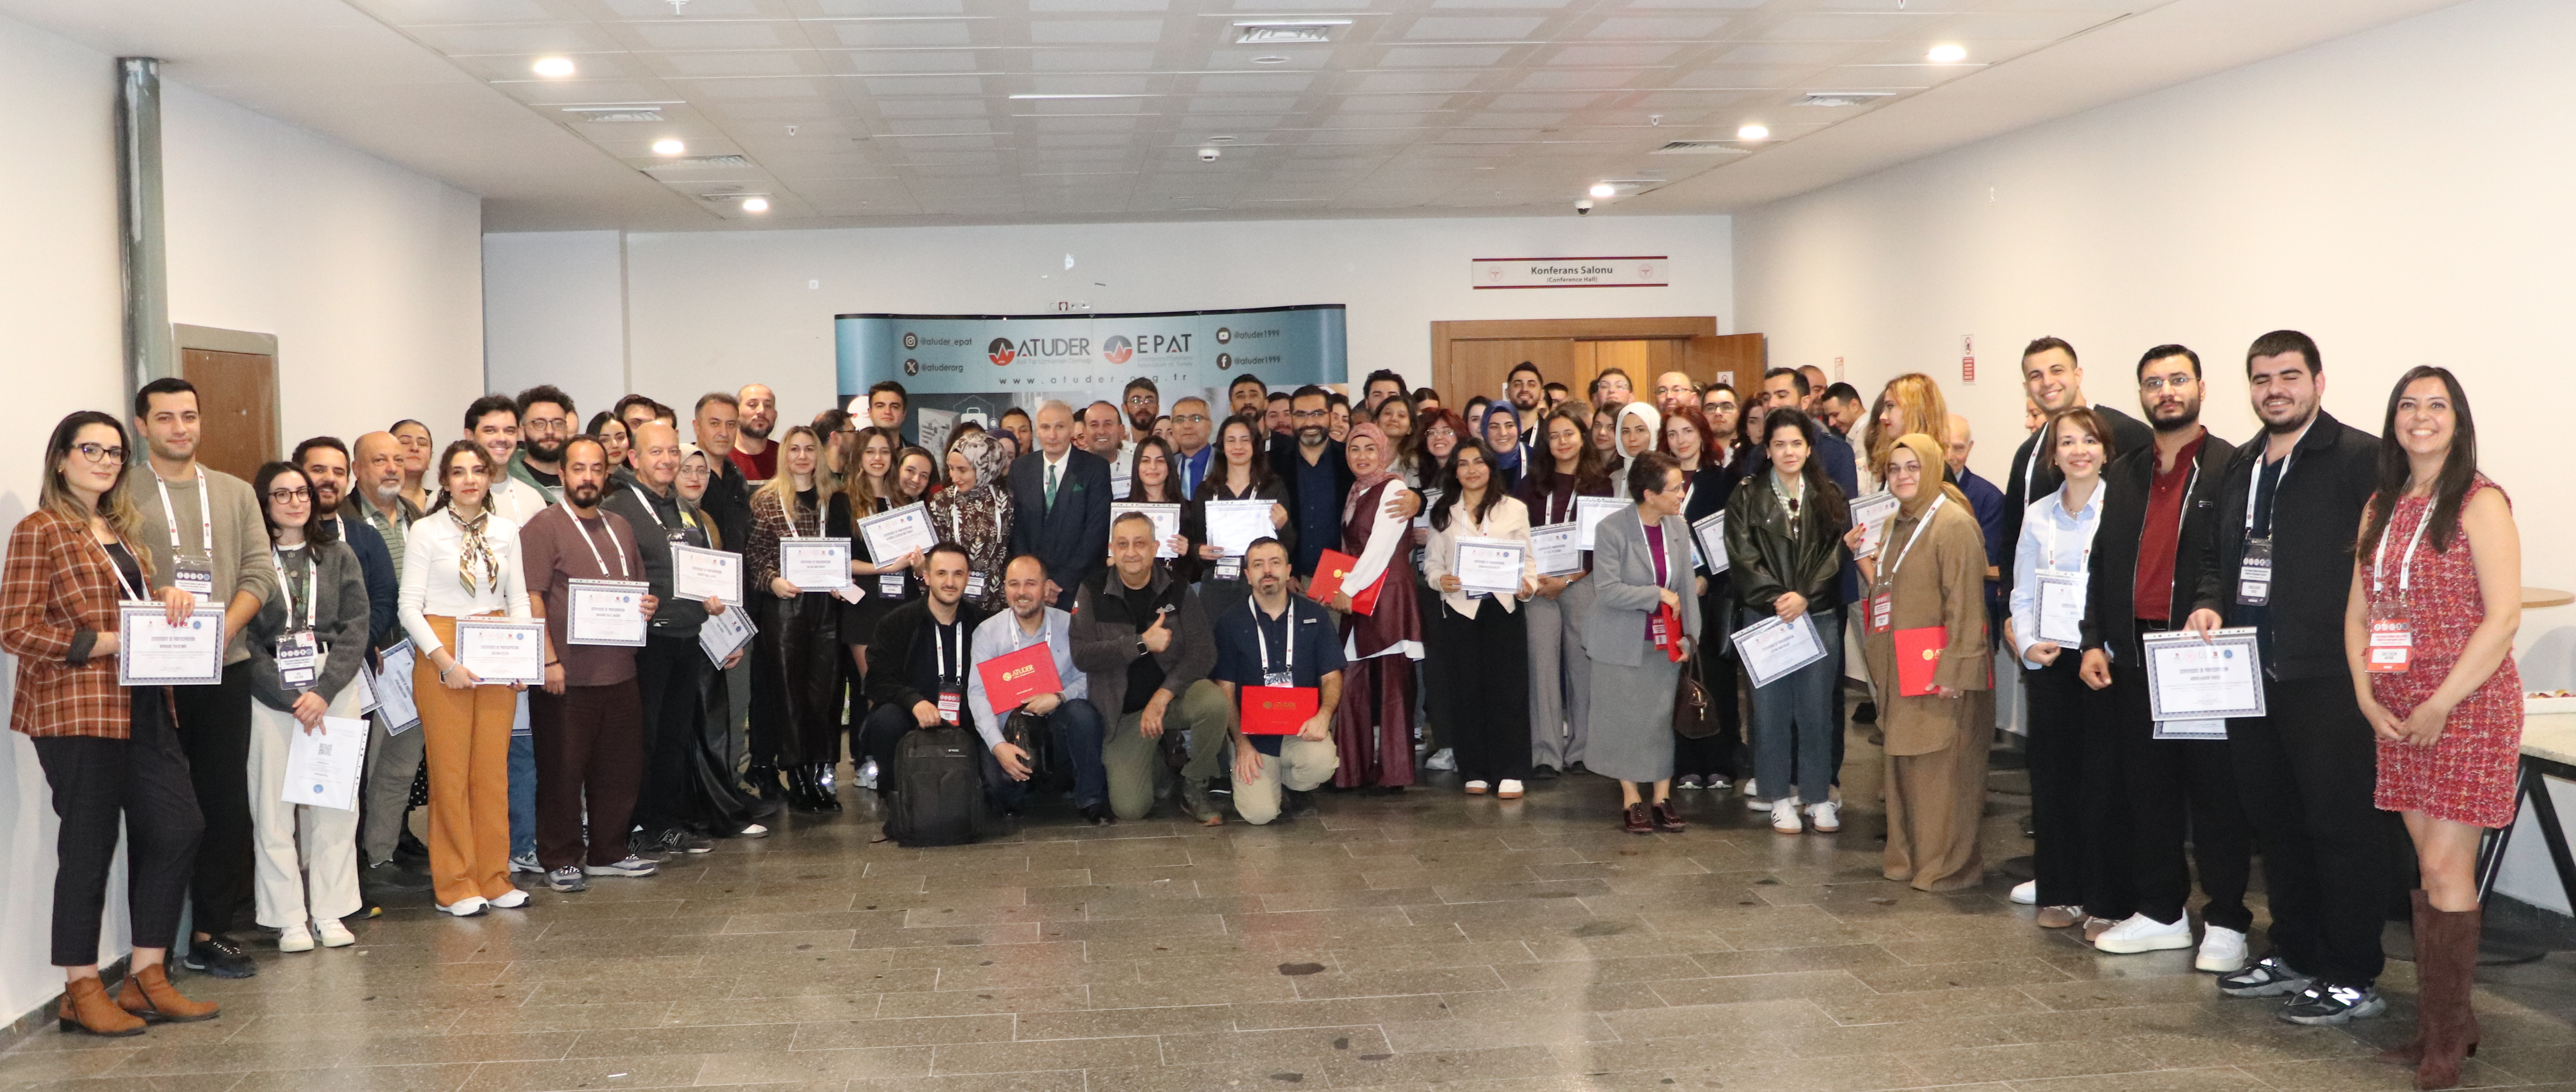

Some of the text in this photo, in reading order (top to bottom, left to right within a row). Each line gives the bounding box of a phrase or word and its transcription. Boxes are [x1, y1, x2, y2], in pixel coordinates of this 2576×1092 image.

[1234, 330, 1280, 339] @atuder1999
[1017, 338, 1091, 357] ATUDER
[1137, 334, 1192, 354] EPAT
[1234, 356, 1280, 365] @atuder1999
[922, 364, 964, 372] @atuderorg
[1013, 665, 1034, 677] ATUDER
